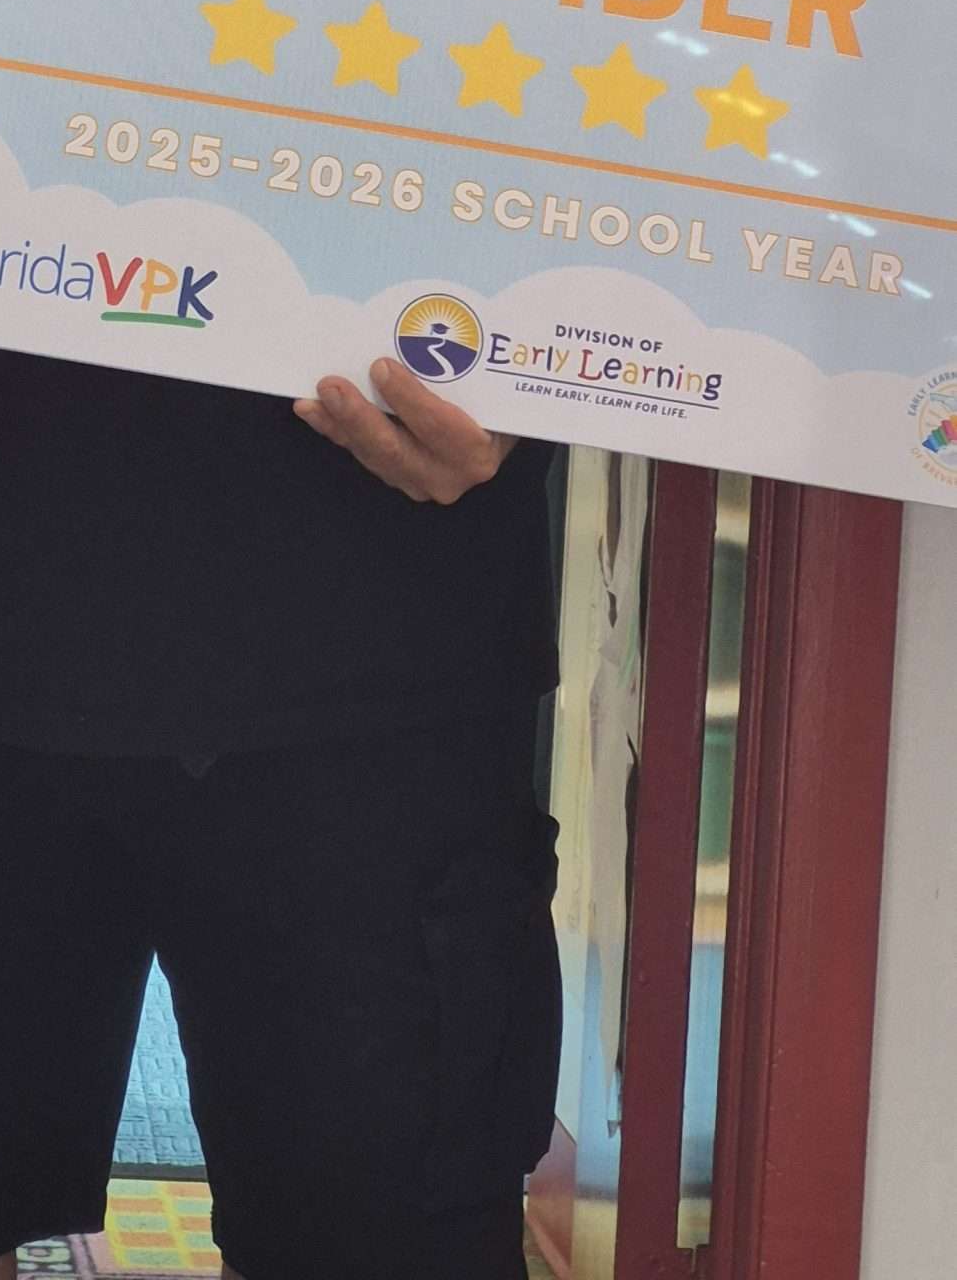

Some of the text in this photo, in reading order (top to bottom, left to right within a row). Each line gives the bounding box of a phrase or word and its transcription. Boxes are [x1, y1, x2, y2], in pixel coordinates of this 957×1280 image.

[451, 179, 715, 264] SCHOOL
[741, 228, 906, 297] YEAR
[554, 324, 664, 354] DIVISION OF
[486, 333, 722, 401] Early Learning
[514, 381, 688, 420] LEARN EARLY. LEARN FOR LIFE.
